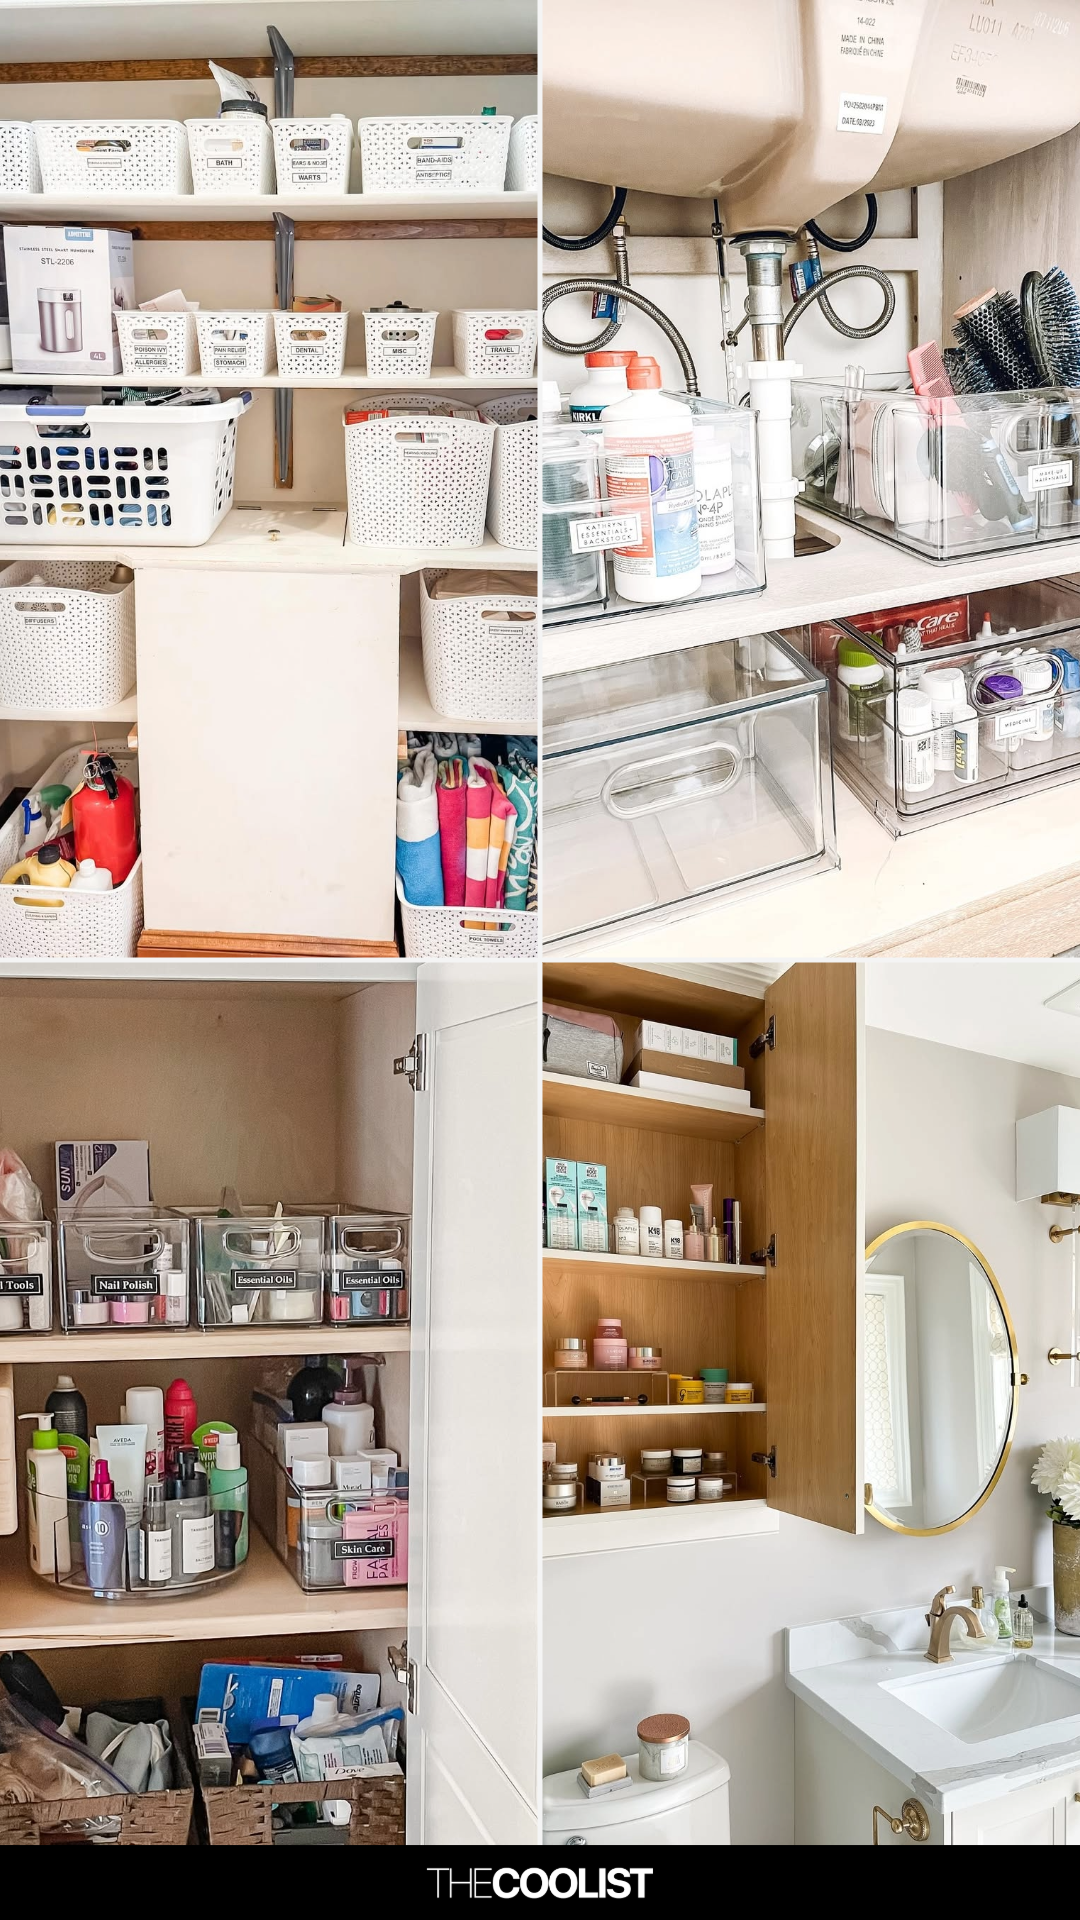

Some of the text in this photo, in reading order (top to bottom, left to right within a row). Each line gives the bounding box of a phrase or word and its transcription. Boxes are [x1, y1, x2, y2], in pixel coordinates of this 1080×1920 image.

[841, 35, 857, 43] MADE
[868, 37, 885, 45] CHINA
[41, 257, 75, 266] STL-2206
[586, 520, 627, 531] KATHRYNE
[583, 535, 632, 545] BACKSTOCK
[1004, 718, 1032, 728] MEDICINE
[956, 735, 965, 769] Advil
[60, 1166, 71, 1193] SUN
[648, 1227, 661, 1236] K18
[237, 1275, 293, 1284] Essential Oils
[345, 1275, 400, 1285] Essential Oils
[6, 1281, 35, 1290] Tools
[99, 1281, 153, 1290] Nail Polish
[341, 1544, 386, 1554] Skin Care
[367, 1524, 379, 1580] FAAL
[378, 1523, 389, 1579] PATES
[351, 1683, 362, 1713] equate
[335, 1767, 366, 1776] Dove
